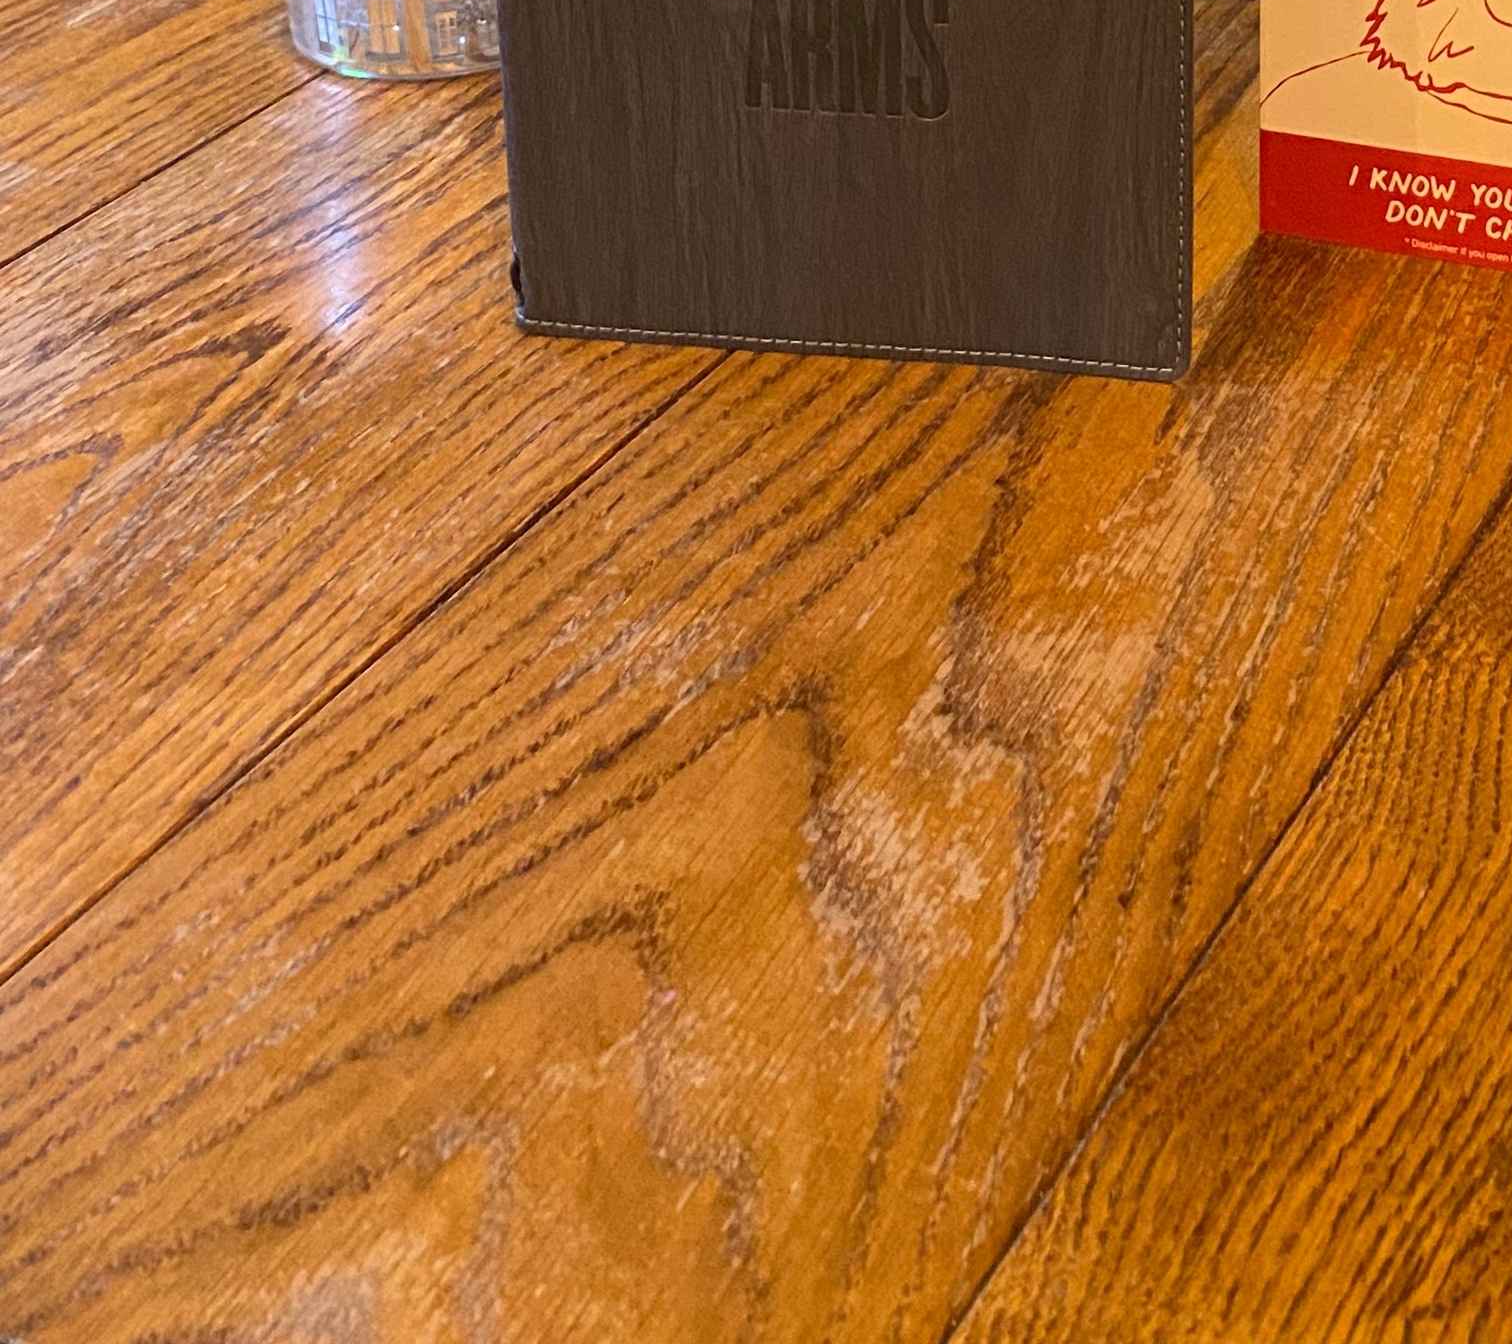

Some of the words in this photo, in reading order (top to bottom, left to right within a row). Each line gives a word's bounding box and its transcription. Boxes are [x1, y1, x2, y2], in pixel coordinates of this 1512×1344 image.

[1349, 165, 1359, 186] I
[1369, 167, 1456, 202] KNOW
[1385, 200, 1476, 234] DON'T
[1468, 249, 1485, 260] you
